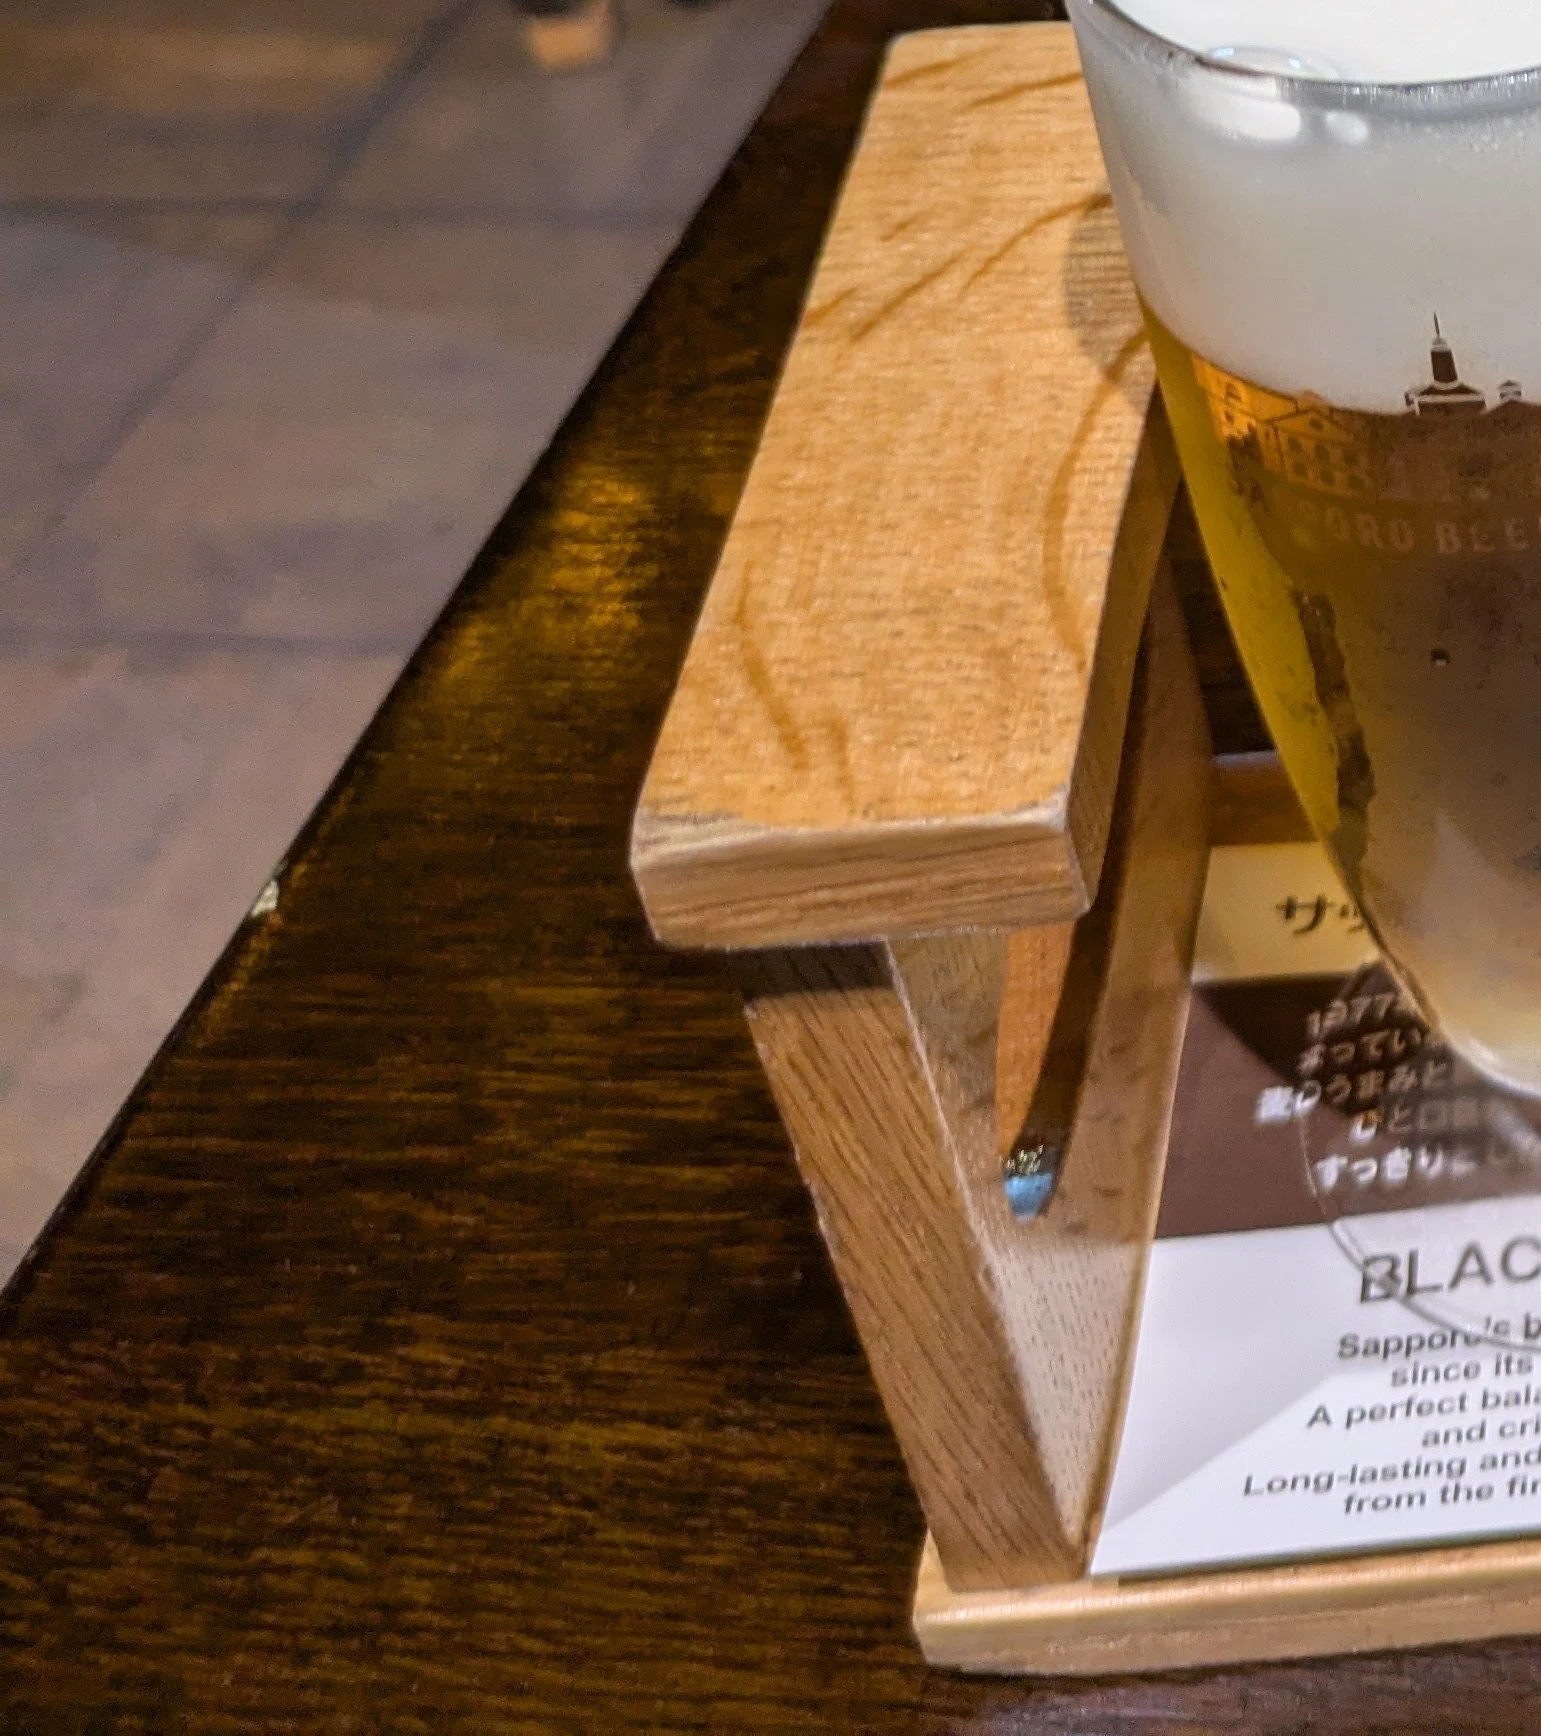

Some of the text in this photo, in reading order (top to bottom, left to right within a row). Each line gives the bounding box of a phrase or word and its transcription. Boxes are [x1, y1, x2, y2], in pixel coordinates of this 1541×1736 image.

[1391, 1360, 1482, 1388] since
[1494, 1351, 1534, 1377] its
[1306, 1403, 1332, 1429] A
[1345, 1392, 1469, 1430] perfect
[1421, 1419, 1487, 1448] and
[1243, 1456, 1468, 1497] Long-lasting
[1342, 1489, 1427, 1516] from
[1438, 1481, 1495, 1505] the
